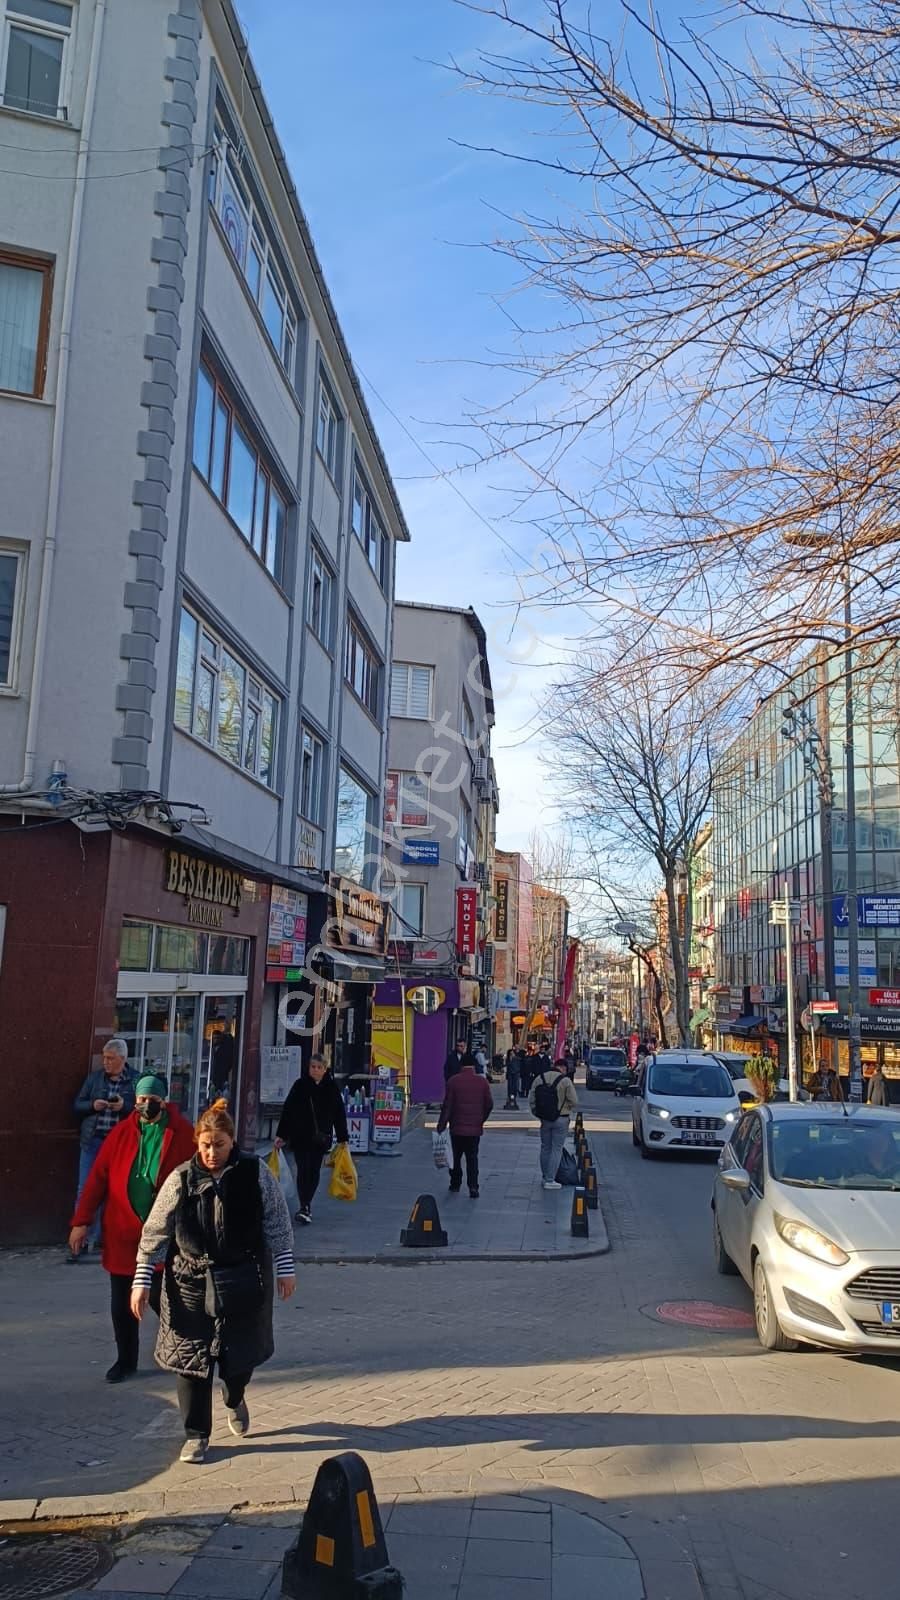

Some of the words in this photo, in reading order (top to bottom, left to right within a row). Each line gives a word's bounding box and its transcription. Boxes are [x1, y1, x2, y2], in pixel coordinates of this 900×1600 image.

[462, 893, 473, 901] 3.
[462, 903, 471, 953] NOTER
[376, 1113, 400, 1121] AVON
